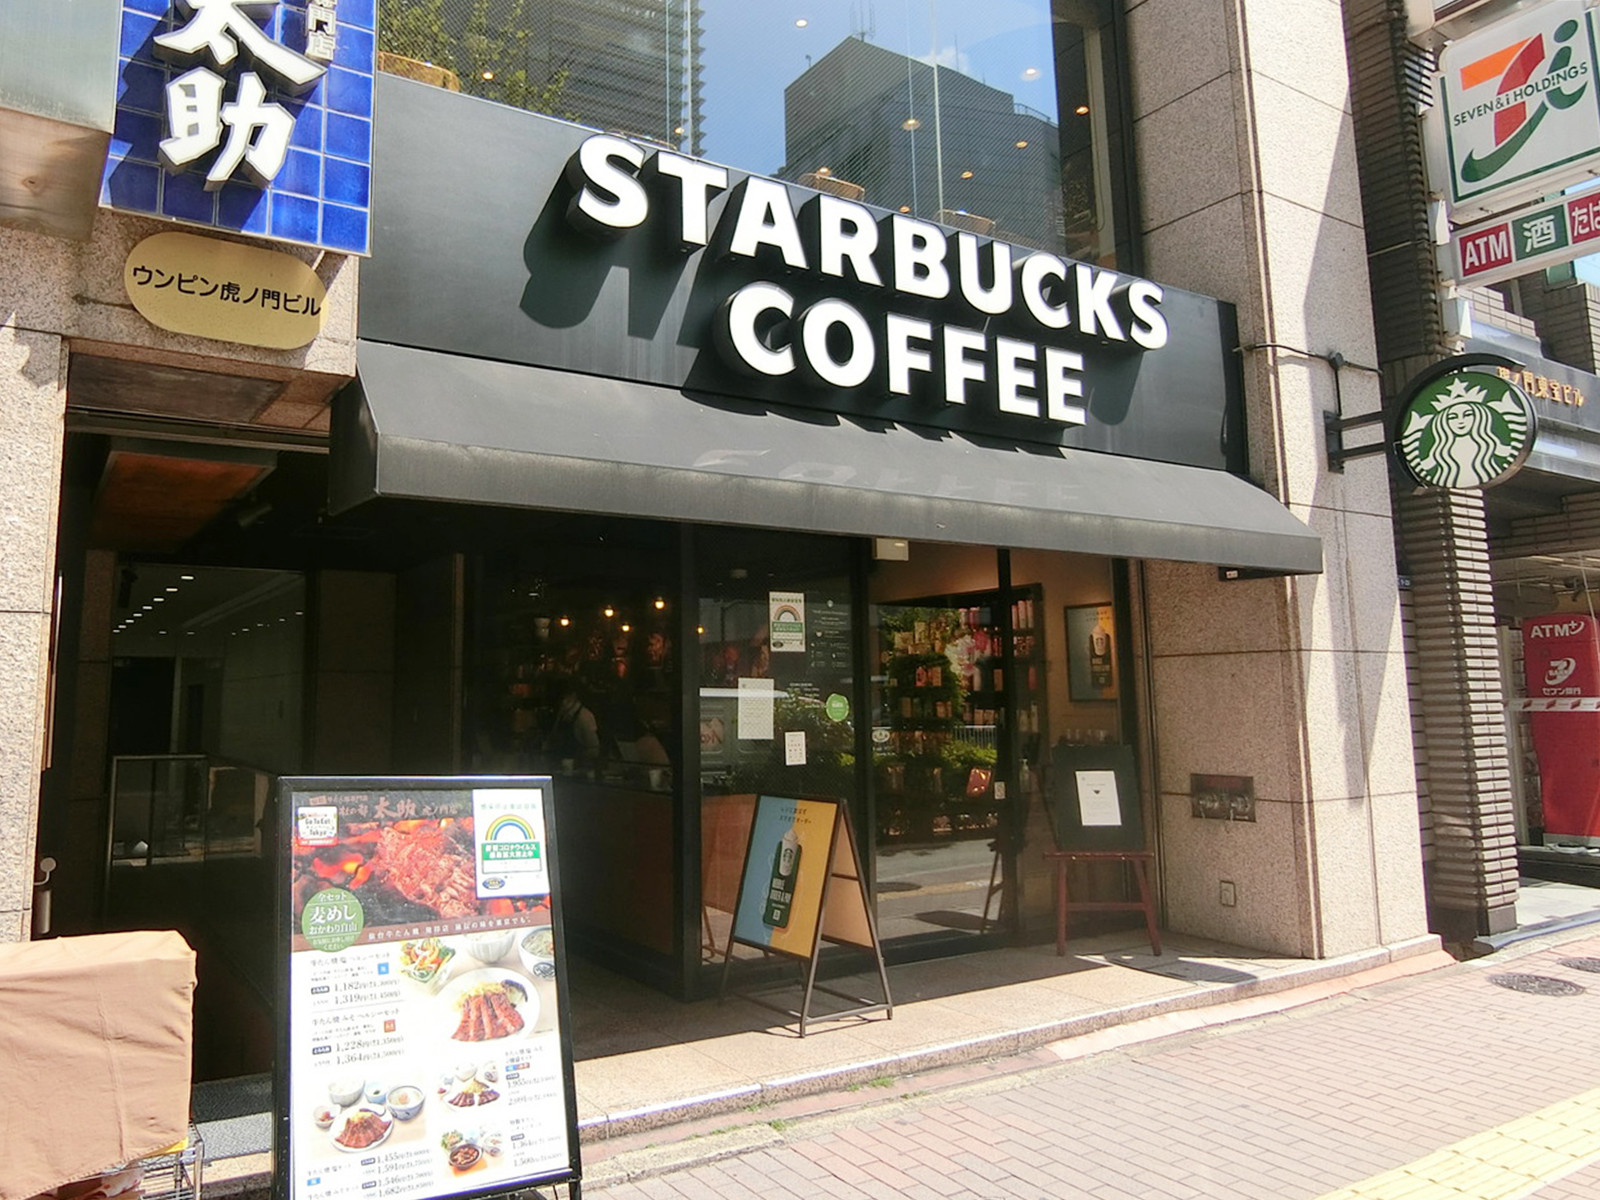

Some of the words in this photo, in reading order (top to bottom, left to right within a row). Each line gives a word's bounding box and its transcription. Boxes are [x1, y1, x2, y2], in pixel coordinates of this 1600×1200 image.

[1513, 61, 1588, 103] HOLDINGS
[578, 133, 1169, 350] STARBUCKS
[1464, 229, 1509, 270] ATM
[1522, 214, 1556, 253] 酒
[132, 265, 322, 318] ウンピン虎ノ門ビル
[728, 281, 1087, 426] COFFEE
[373, 796, 419, 819] 太助
[310, 904, 358, 925] 麦めし
